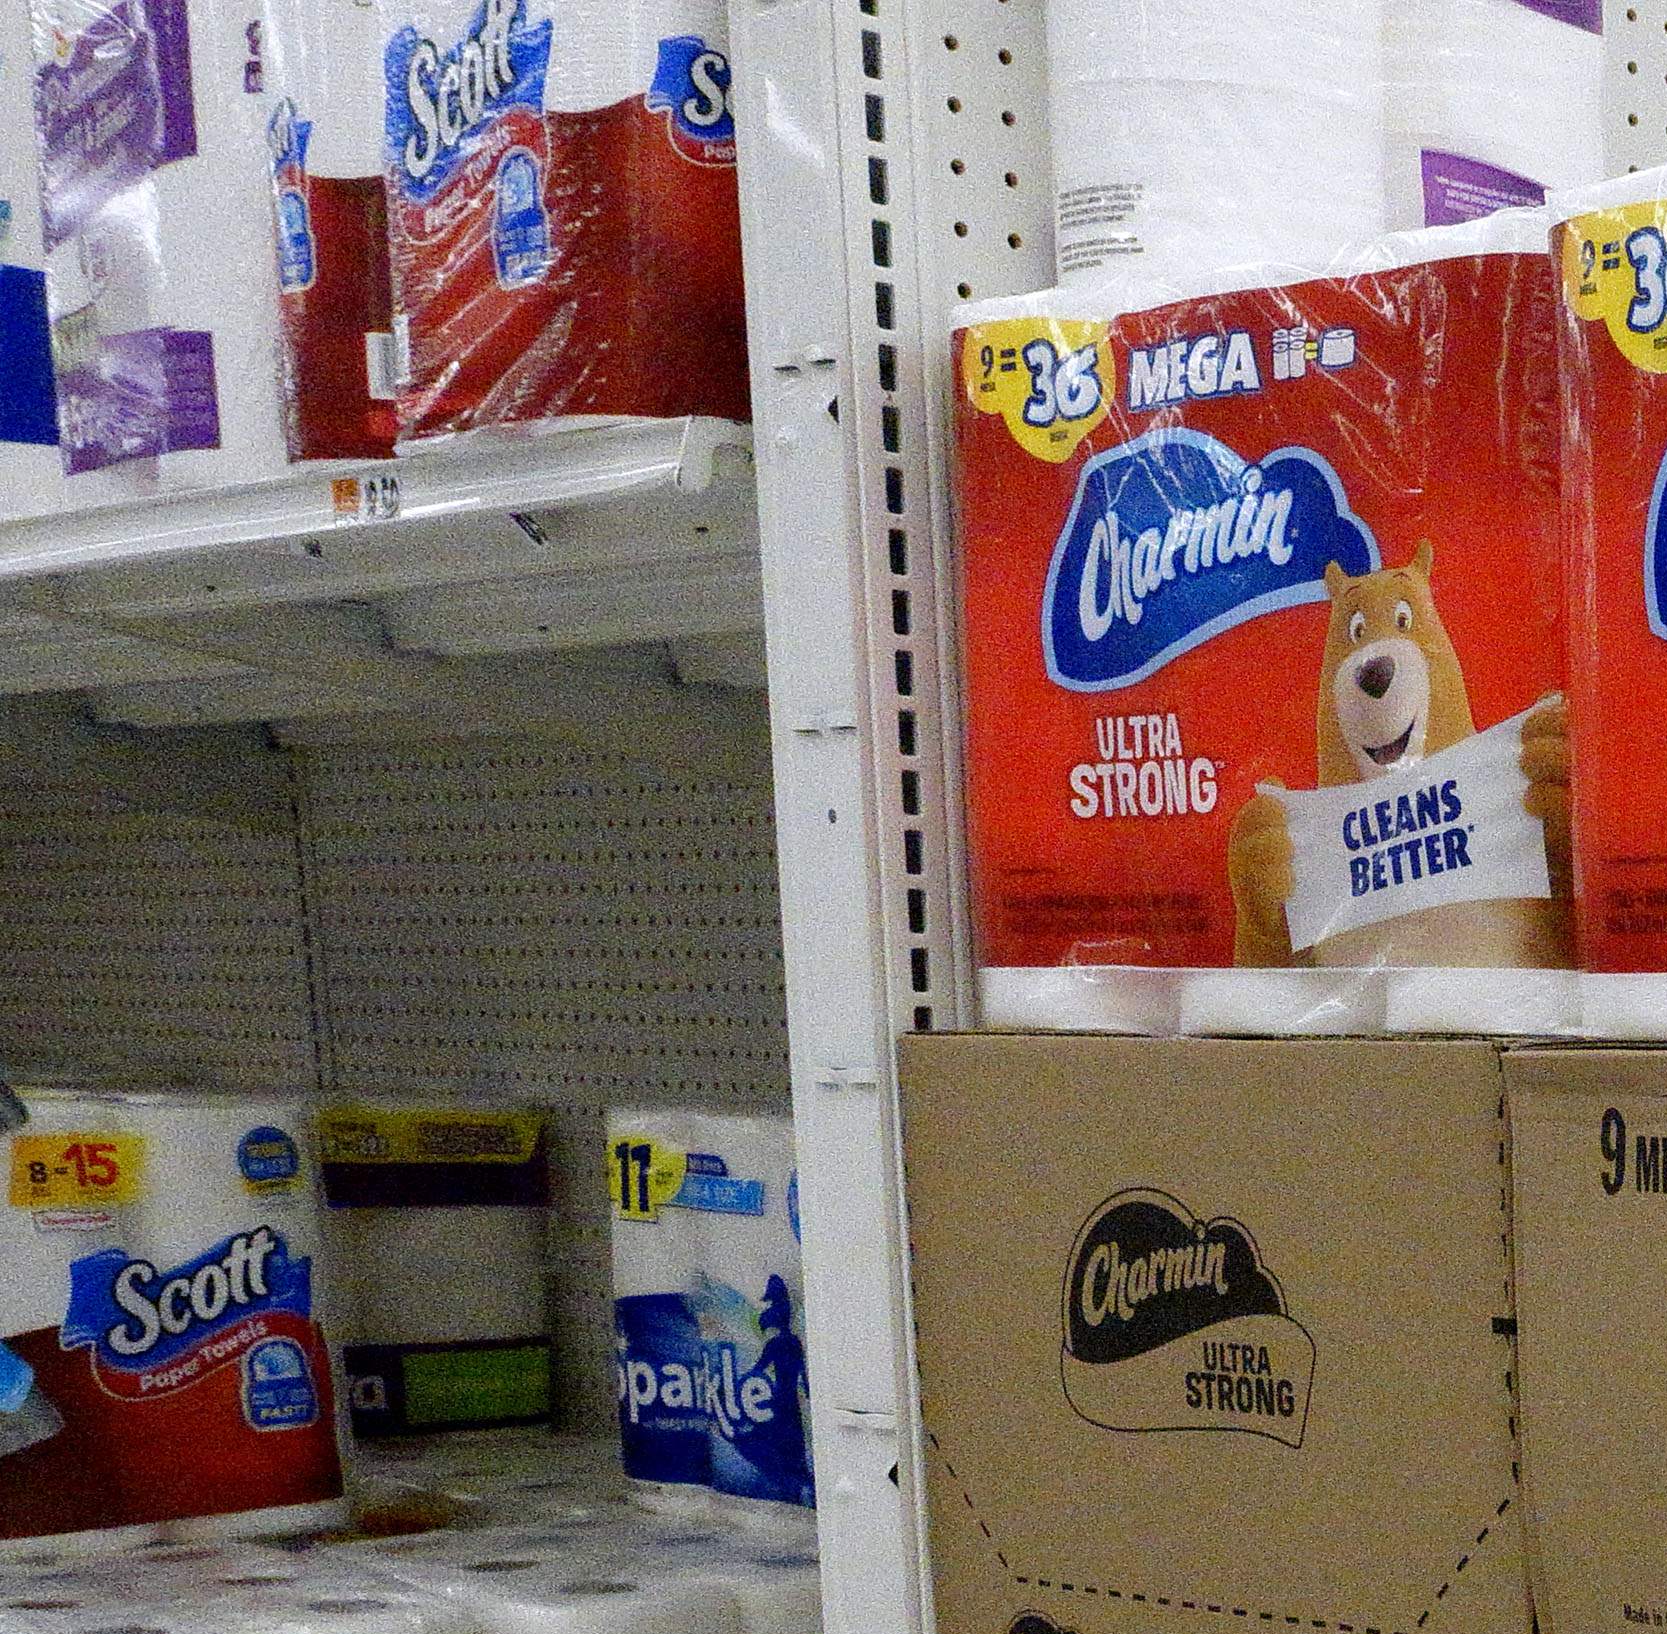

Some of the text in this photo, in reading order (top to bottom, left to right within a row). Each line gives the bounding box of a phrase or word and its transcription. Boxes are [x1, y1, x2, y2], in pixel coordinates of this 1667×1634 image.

[1025, 339, 1102, 428] 36
[1129, 332, 1260, 408] MEGA
[1079, 465, 1297, 641] Charmin
[1096, 713, 1181, 761] ULTRA
[1070, 758, 1218, 819] STRONG
[1342, 779, 1462, 852] CLEANS
[64, 1143, 120, 1187] 15
[616, 1142, 651, 1212] 11
[1600, 1108, 1626, 1197] 9
[108, 1226, 275, 1356] Scott
[1080, 1219, 1230, 1328] Charmin
[199, 1319, 268, 1361] Towels
[1202, 1342, 1271, 1375] ULTRA
[1185, 1370, 1295, 1418] STRONG
